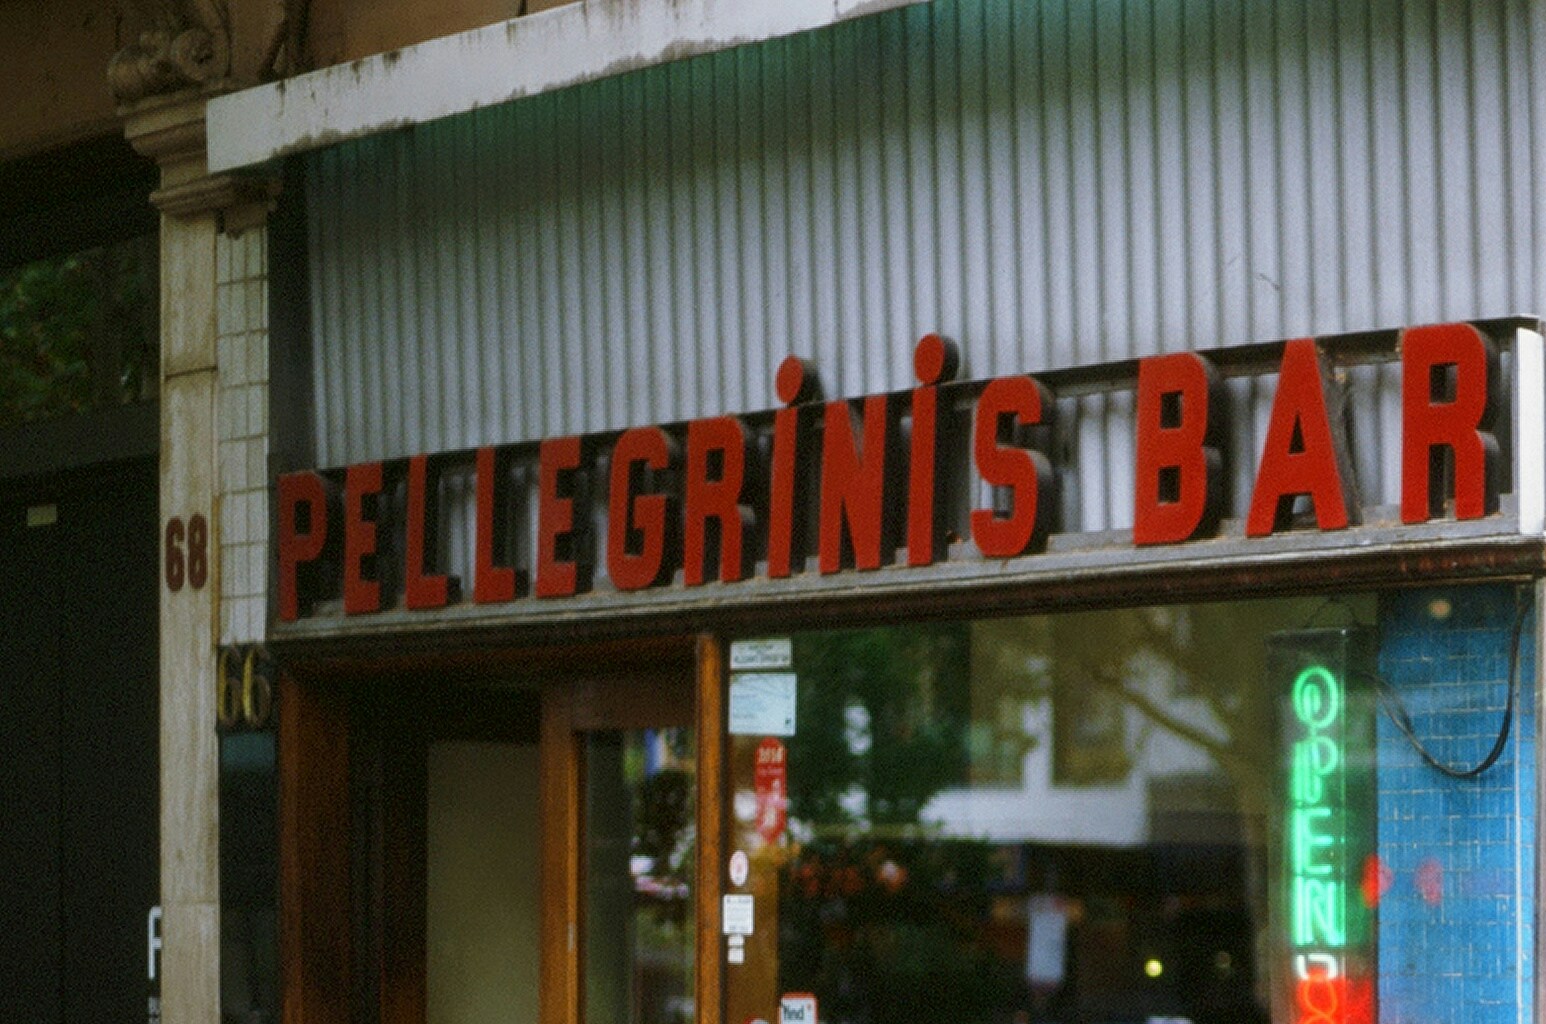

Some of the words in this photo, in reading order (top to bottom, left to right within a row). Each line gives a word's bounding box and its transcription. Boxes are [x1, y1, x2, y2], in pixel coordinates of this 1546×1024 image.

[1133, 322, 1498, 546] BAR
[164, 514, 209, 593] 68
[218, 643, 272, 729] 66
[1290, 664, 1347, 947] OPEN
